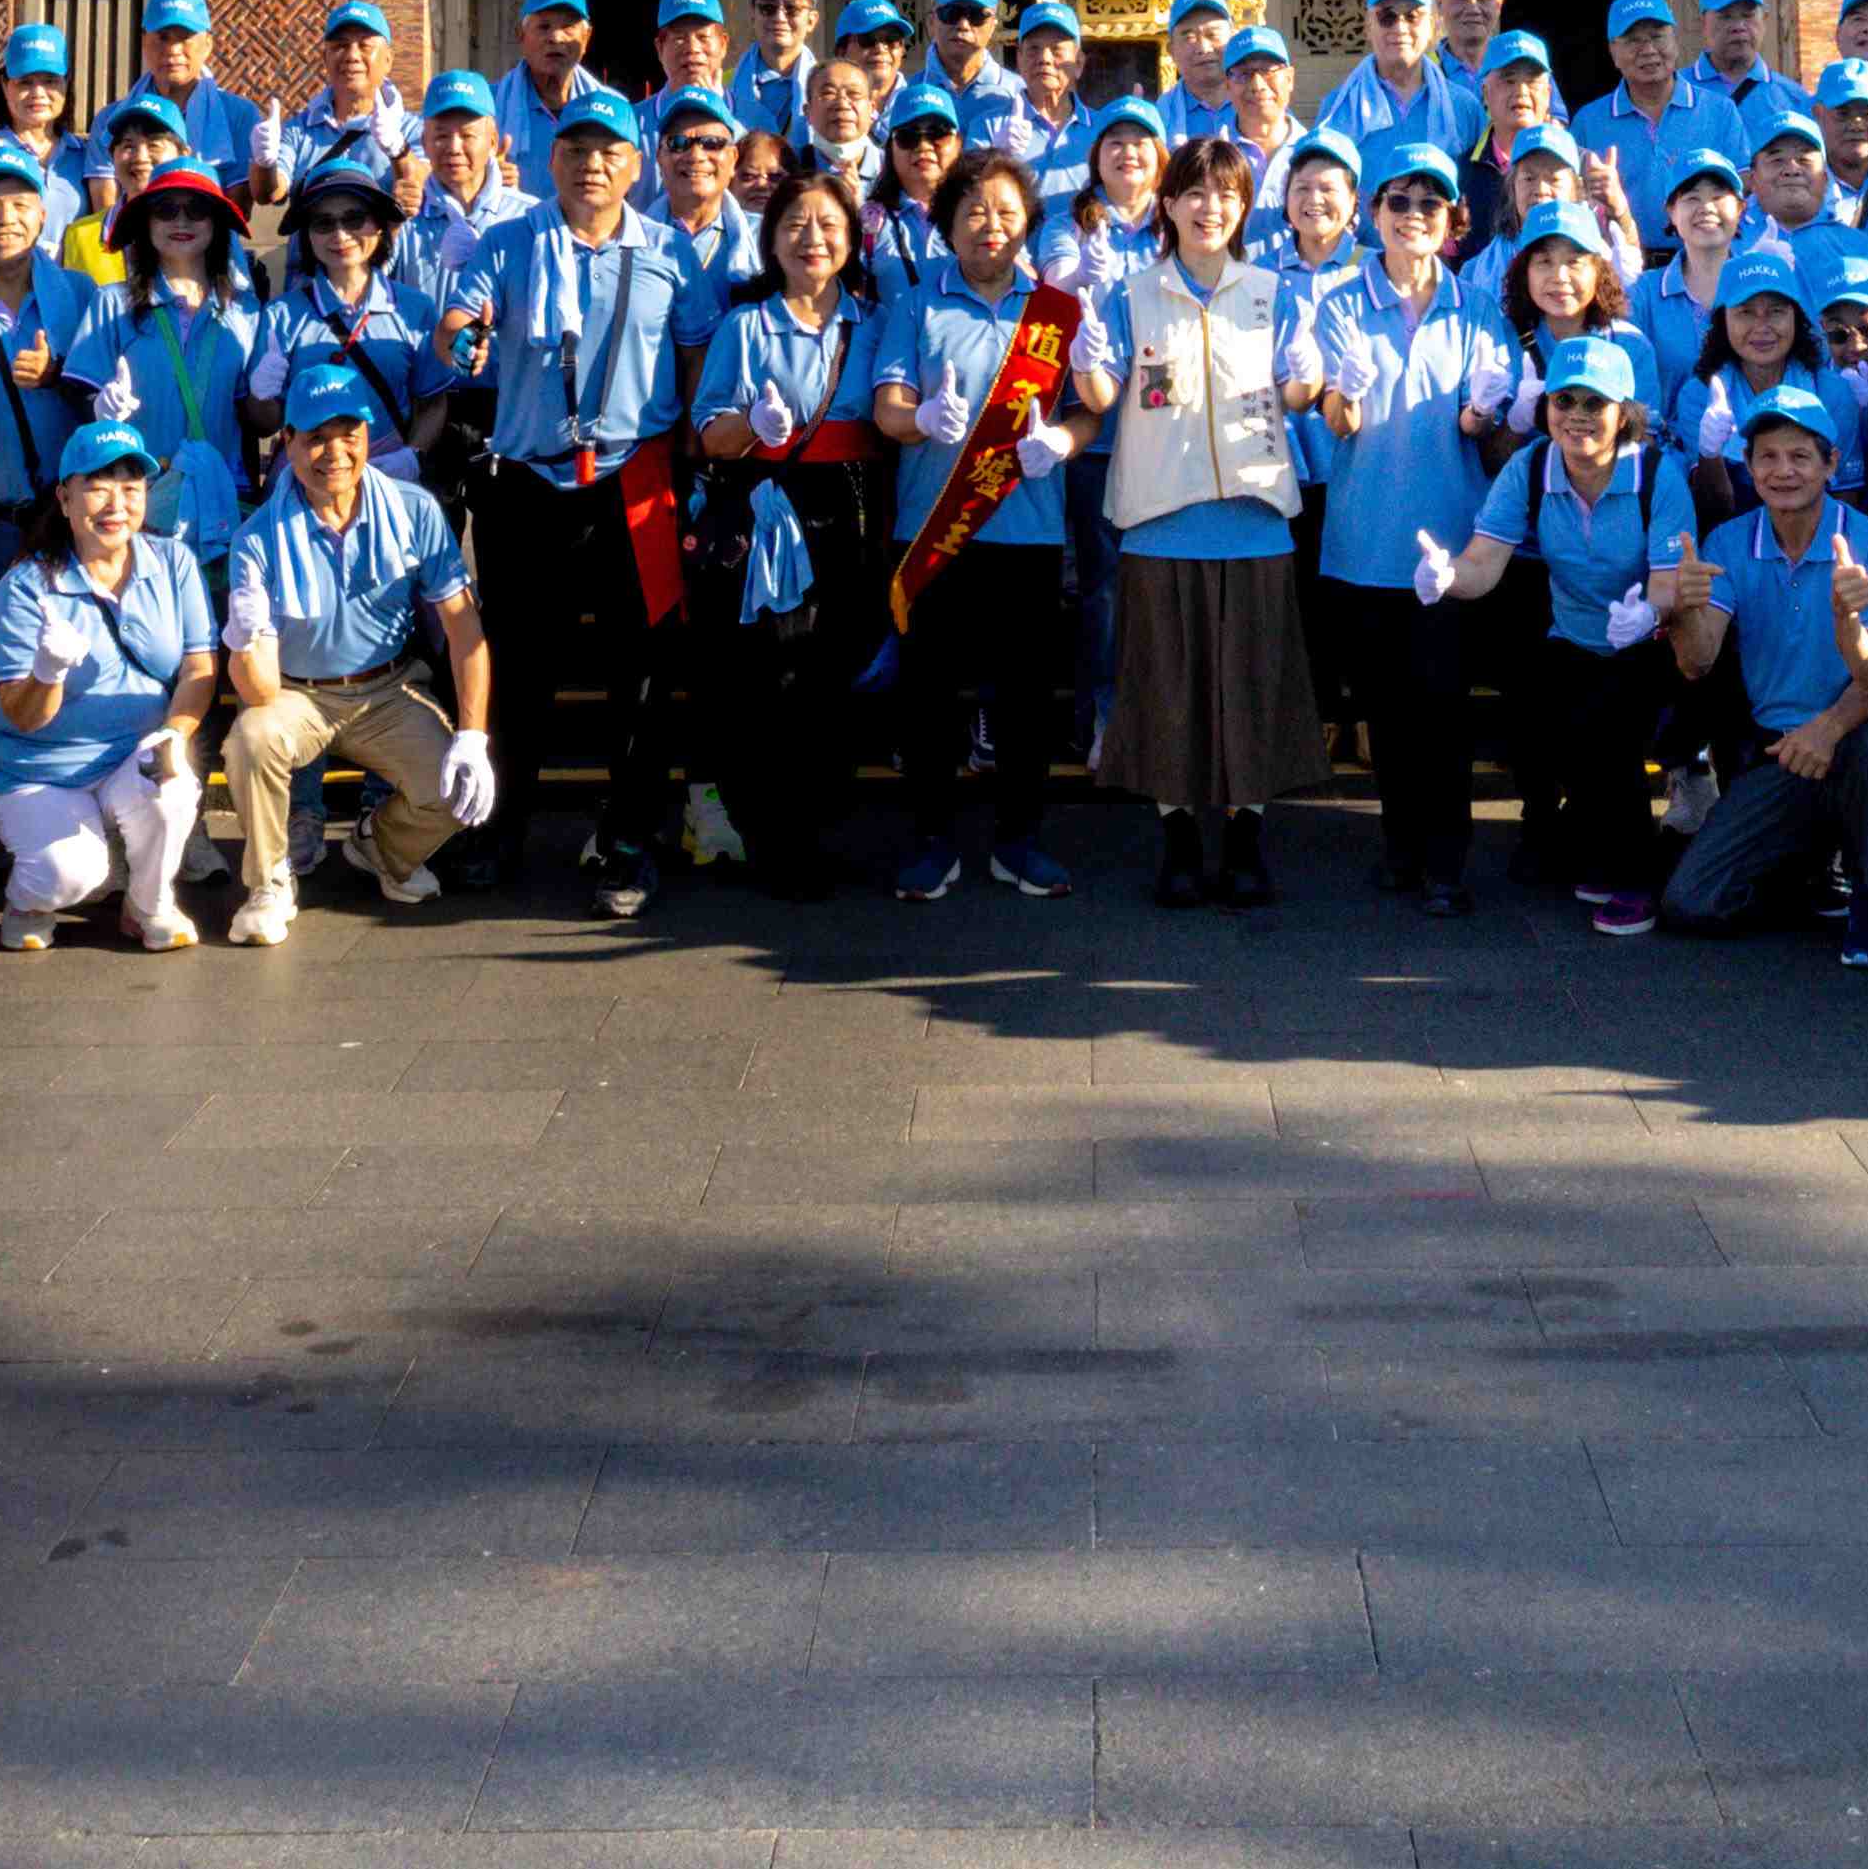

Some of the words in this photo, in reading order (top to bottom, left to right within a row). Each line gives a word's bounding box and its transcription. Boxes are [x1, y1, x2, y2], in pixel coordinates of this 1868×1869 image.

[160, 0, 194, 12] HAKKA
[1621, 0, 1654, 12] HAKKA
[20, 39, 56, 52] HAKKA
[1739, 264, 1780, 279] HAKKA
[310, 381, 350, 397] HAKKA
[97, 429, 139, 445] HAKKA
